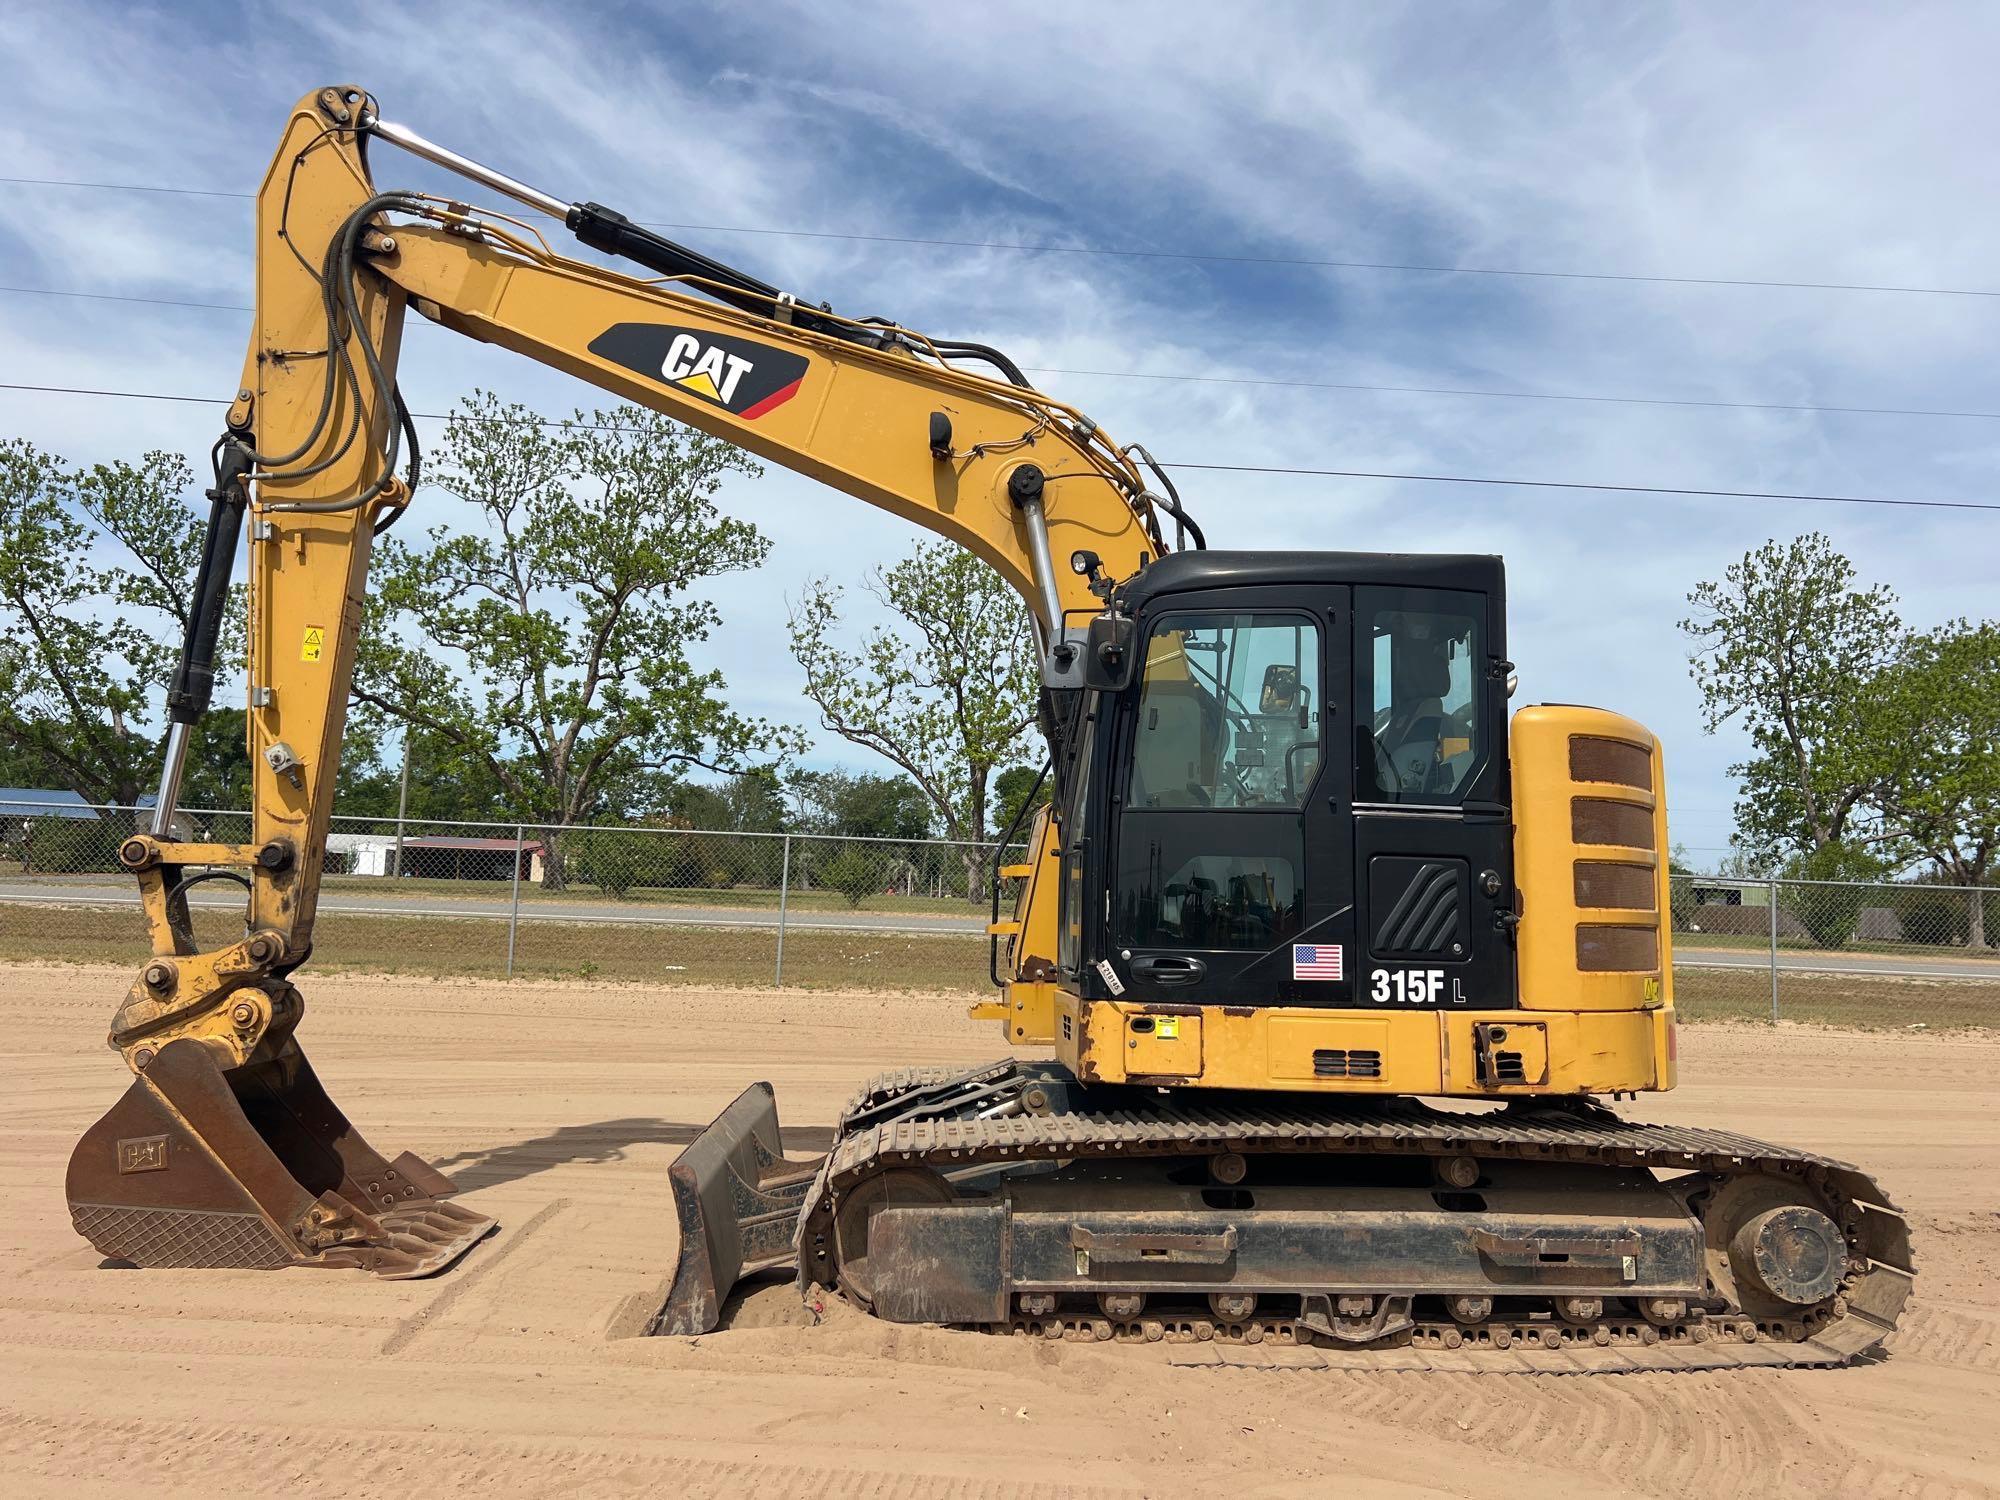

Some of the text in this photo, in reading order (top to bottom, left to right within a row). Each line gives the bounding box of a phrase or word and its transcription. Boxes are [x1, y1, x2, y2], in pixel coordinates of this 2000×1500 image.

[661, 333, 754, 405] CAT
[1371, 969, 1466, 1003] 315F L
[124, 1140, 165, 1169] CAT
